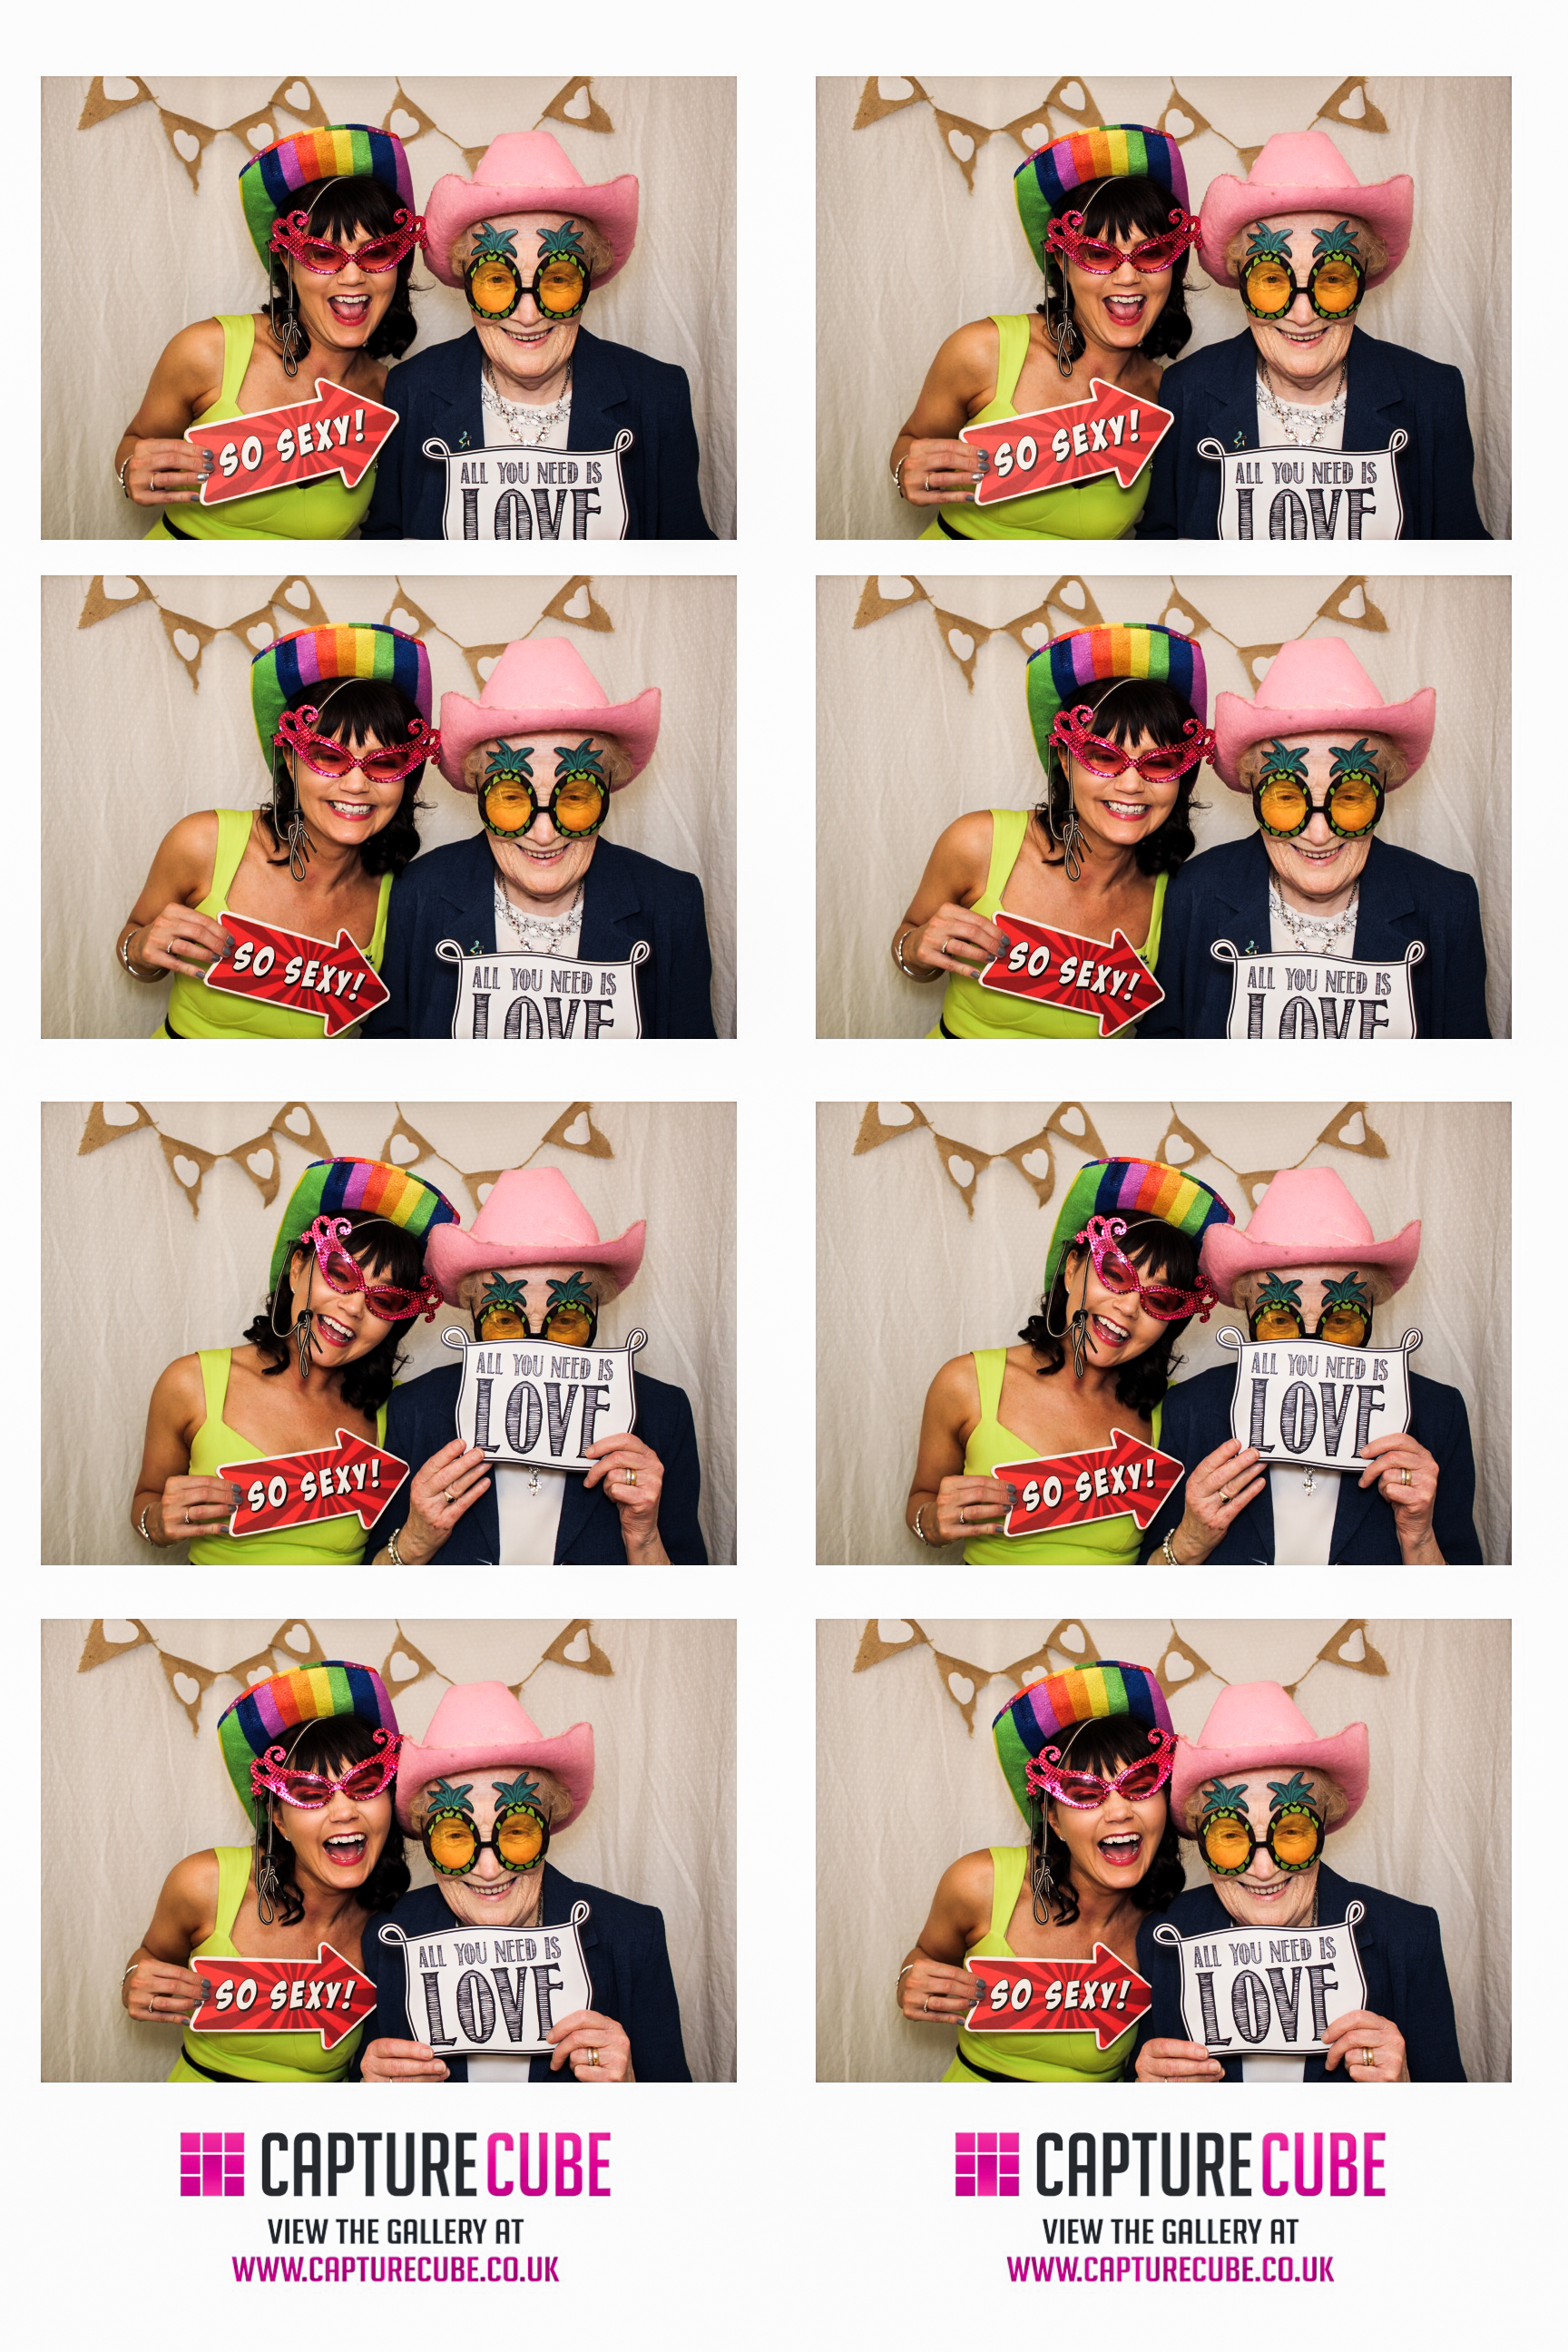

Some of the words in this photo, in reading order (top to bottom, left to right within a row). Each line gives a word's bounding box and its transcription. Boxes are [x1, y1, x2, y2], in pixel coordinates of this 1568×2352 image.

[219, 435, 263, 477] SO
[276, 408, 365, 463] SEXY!
[994, 435, 1038, 477] SO
[1051, 408, 1140, 463] SEXY!
[461, 462, 488, 484] ALL
[497, 462, 529, 485] YOU
[537, 461, 578, 484] NEED
[586, 461, 603, 484] IS
[1236, 462, 1263, 484] ALL
[1272, 462, 1304, 485] YOU
[1312, 461, 1353, 484] NEED
[1361, 461, 1377, 484] IS
[232, 941, 275, 977] SO
[283, 956, 366, 1002] SEXY!
[472, 965, 501, 990] ALL
[510, 967, 543, 992] YOU
[550, 969, 593, 994] NEED
[600, 972, 617, 995] IS
[1007, 941, 1050, 977] SO
[1058, 956, 1141, 1002] SEXY!
[1247, 965, 1276, 990] ALL
[1285, 967, 1318, 992] YOU
[1325, 969, 1367, 994] NEED
[1375, 972, 1392, 995] IS
[476, 1352, 504, 1375] ALL
[513, 1354, 544, 1377] YOU
[551, 1356, 591, 1380] NEED
[598, 1358, 613, 1381] IS
[1251, 1352, 1279, 1375] ALL
[1288, 1354, 1319, 1377] YOU
[1326, 1356, 1366, 1380] NEED
[1373, 1358, 1388, 1381] IS
[247, 1475, 289, 1513] SO
[299, 1458, 380, 1502] SEXY!
[1022, 1475, 1063, 1513] SO
[1074, 1458, 1155, 1502] SEXY!
[419, 1945, 446, 1968] ALL
[454, 1941, 487, 1966] YOU
[495, 1938, 536, 1964] NEED
[544, 1936, 562, 1960] IS
[1194, 1945, 1221, 1968] ALL
[1229, 1941, 1262, 1966] YOU
[1269, 1938, 1311, 1964] NEED
[1319, 1936, 1337, 1960] IS
[215, 1978, 258, 2012] SO
[270, 1979, 356, 2012] SEXY!
[990, 1978, 1033, 2012] SO
[1044, 1979, 1131, 2012] SEXY!
